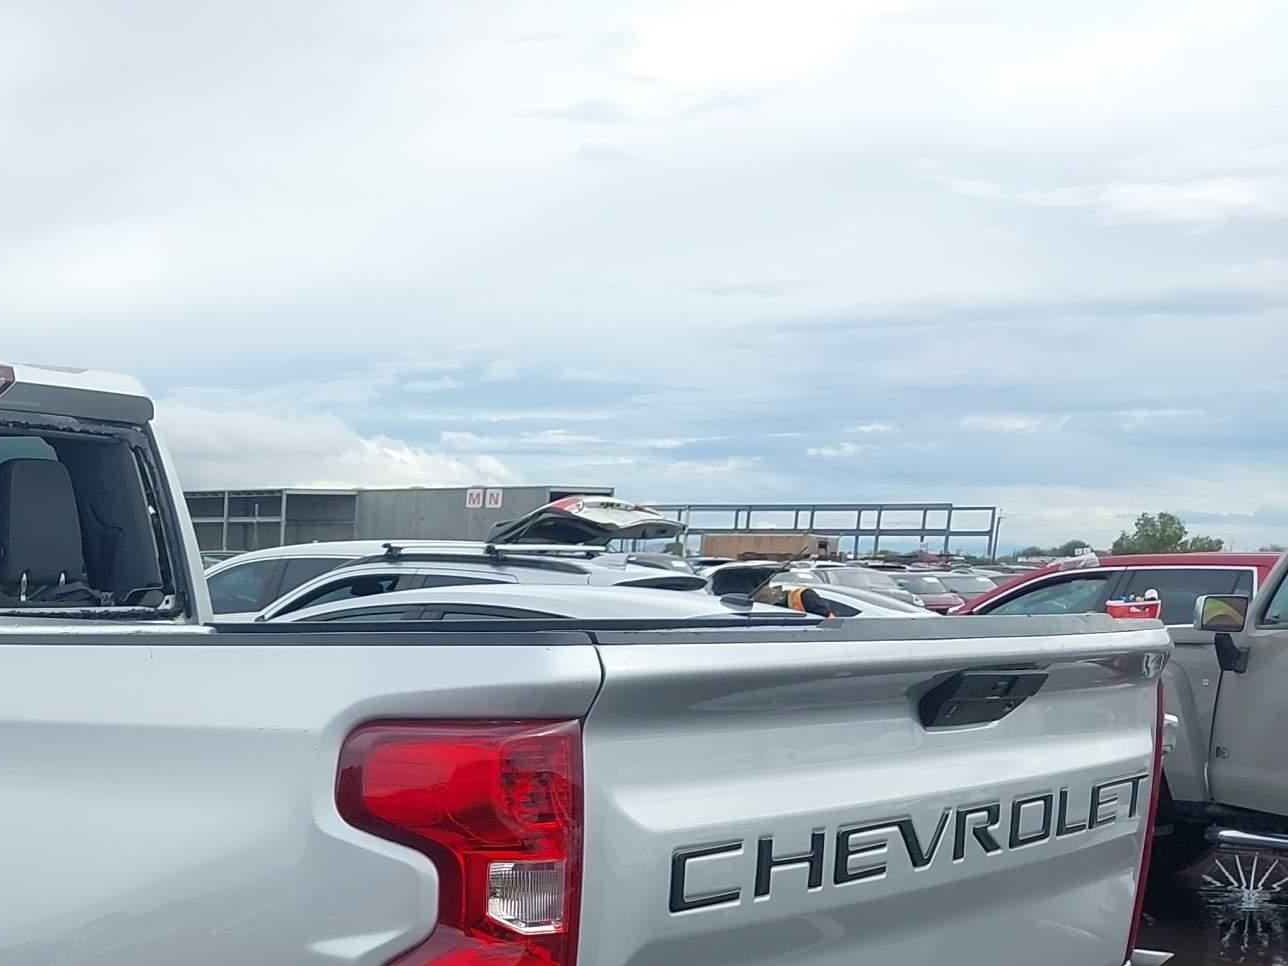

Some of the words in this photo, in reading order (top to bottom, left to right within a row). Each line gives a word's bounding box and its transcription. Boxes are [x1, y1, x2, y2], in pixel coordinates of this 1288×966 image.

[468, 493, 481, 505] M
[488, 493, 500, 505] N
[669, 774, 1148, 914] CHEVROLET
